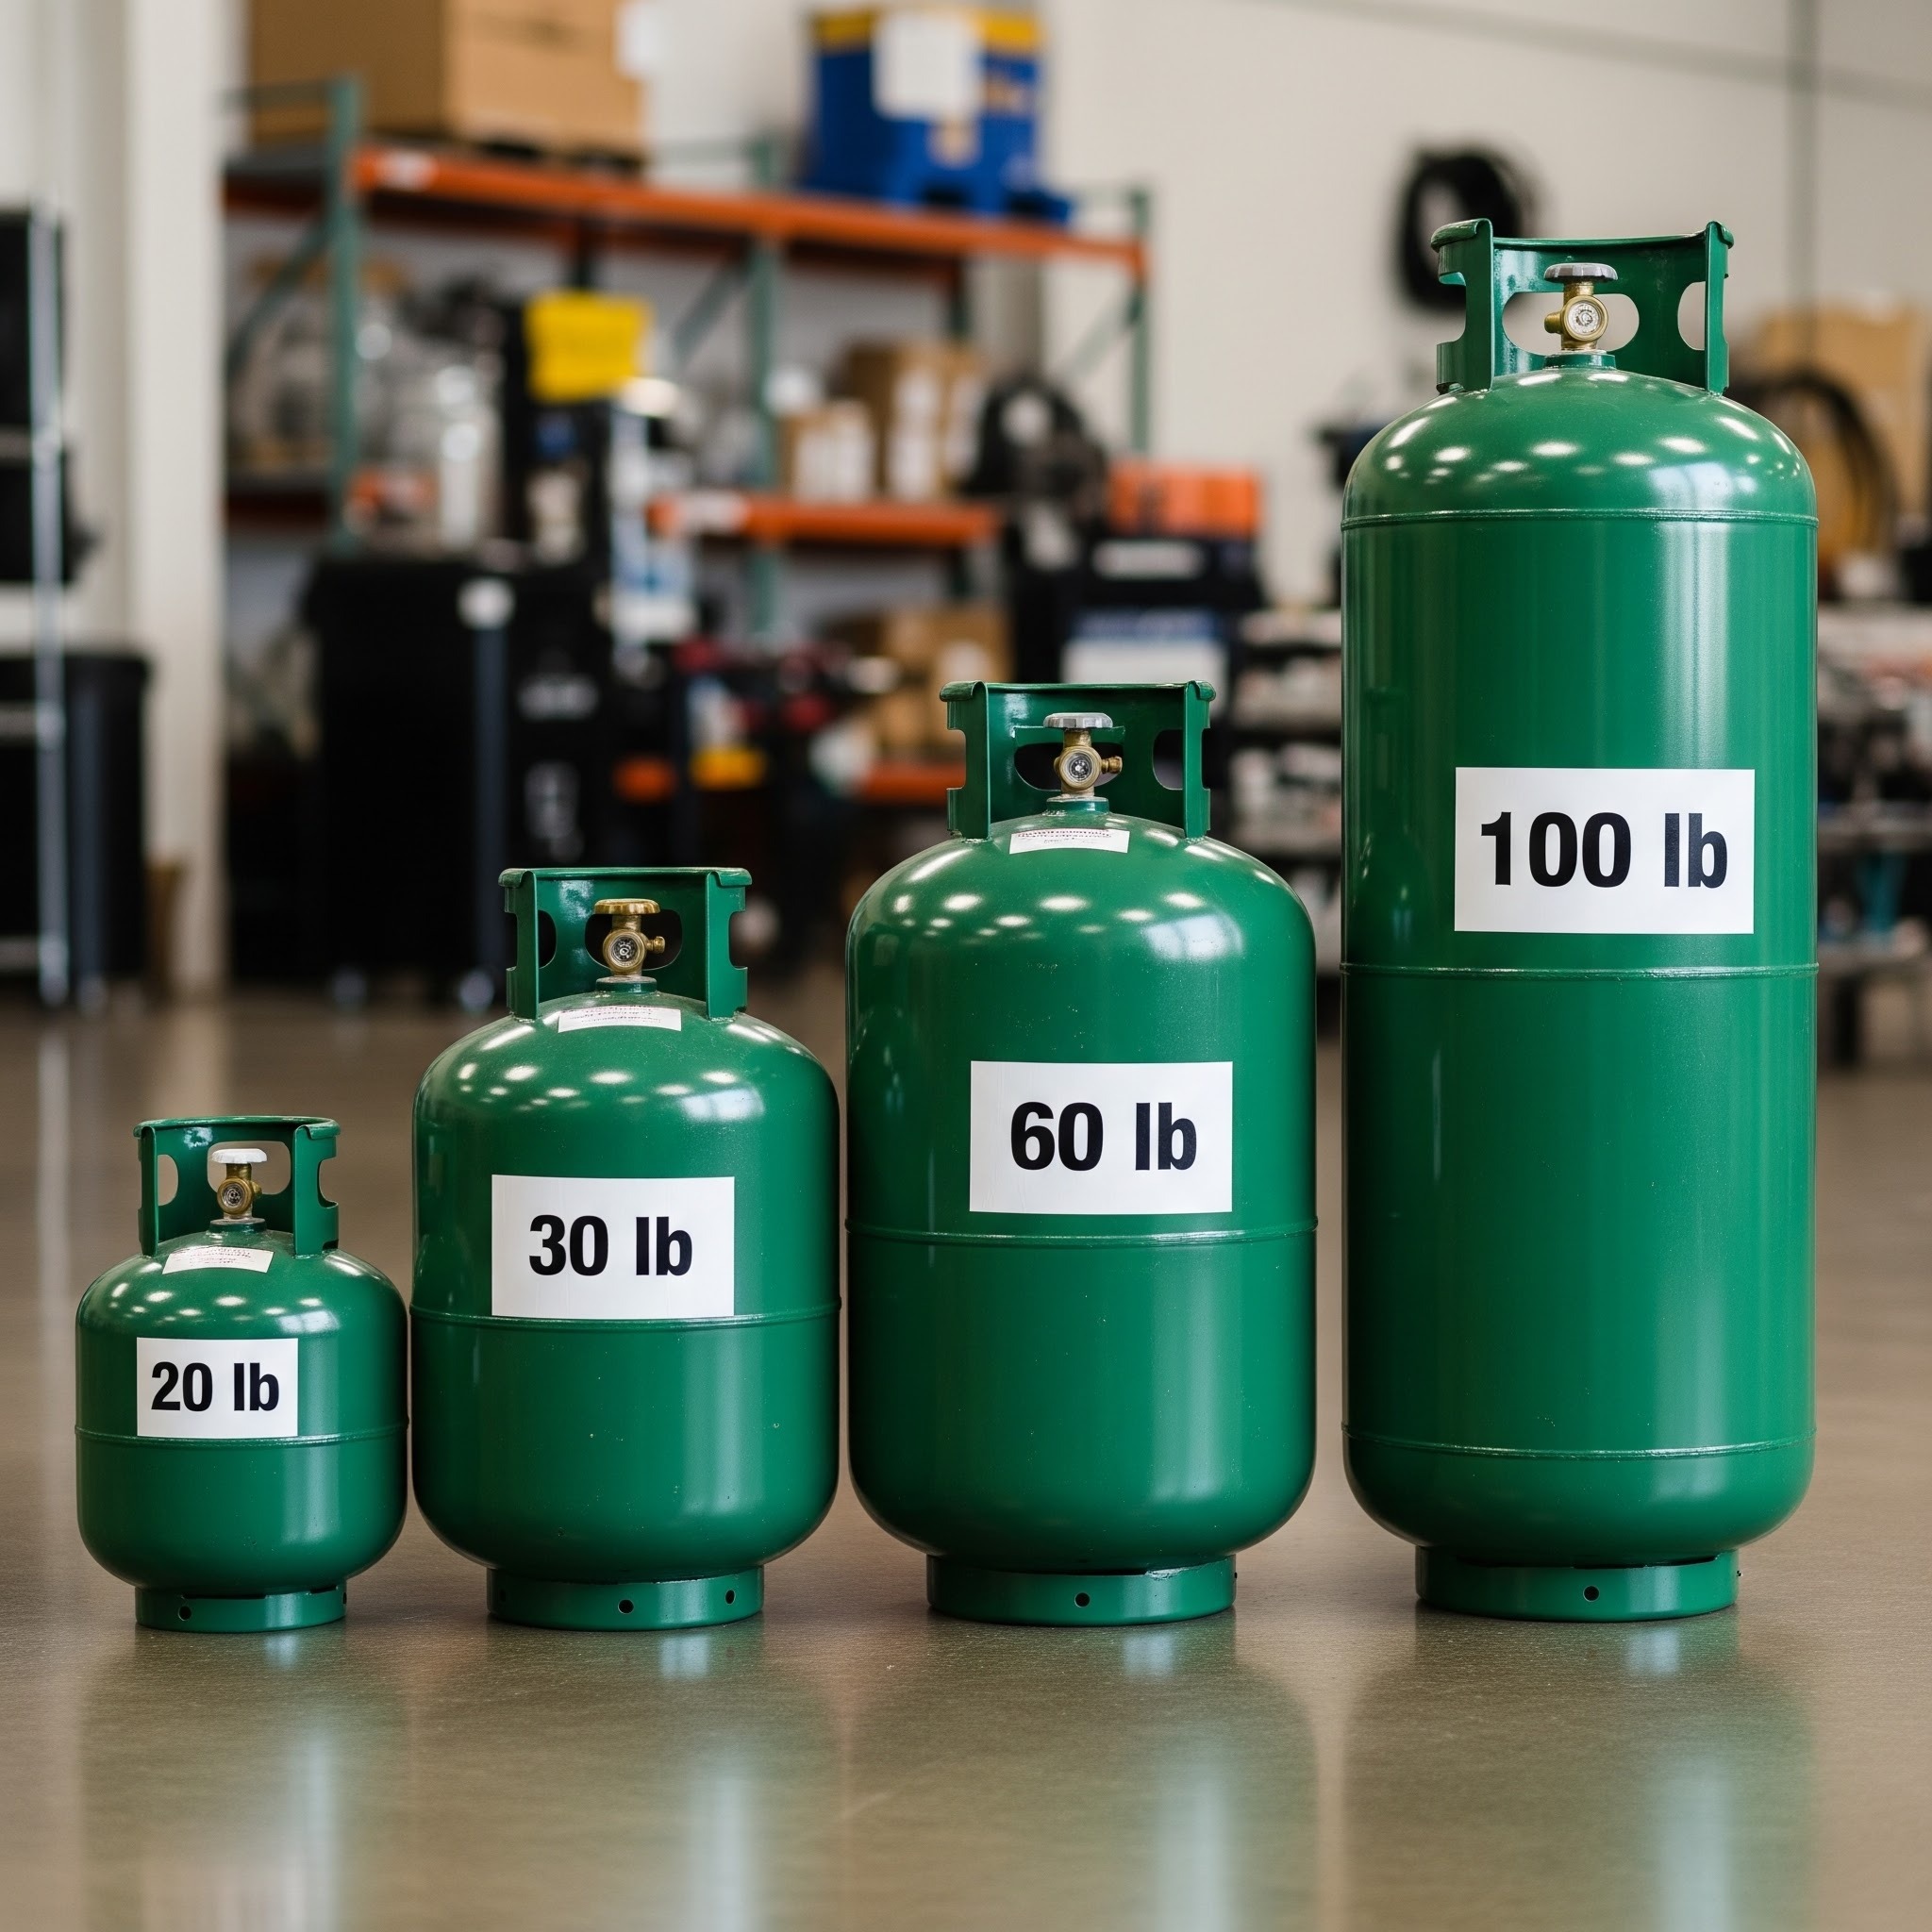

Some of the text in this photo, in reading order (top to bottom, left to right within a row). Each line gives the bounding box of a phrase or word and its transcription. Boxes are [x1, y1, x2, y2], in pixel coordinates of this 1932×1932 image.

[1480, 811, 1729, 889] 100 lb
[1010, 1101, 1198, 1172] 60 lb
[528, 1214, 692, 1276] 30 lb
[151, 1361, 279, 1412] 20 lb
